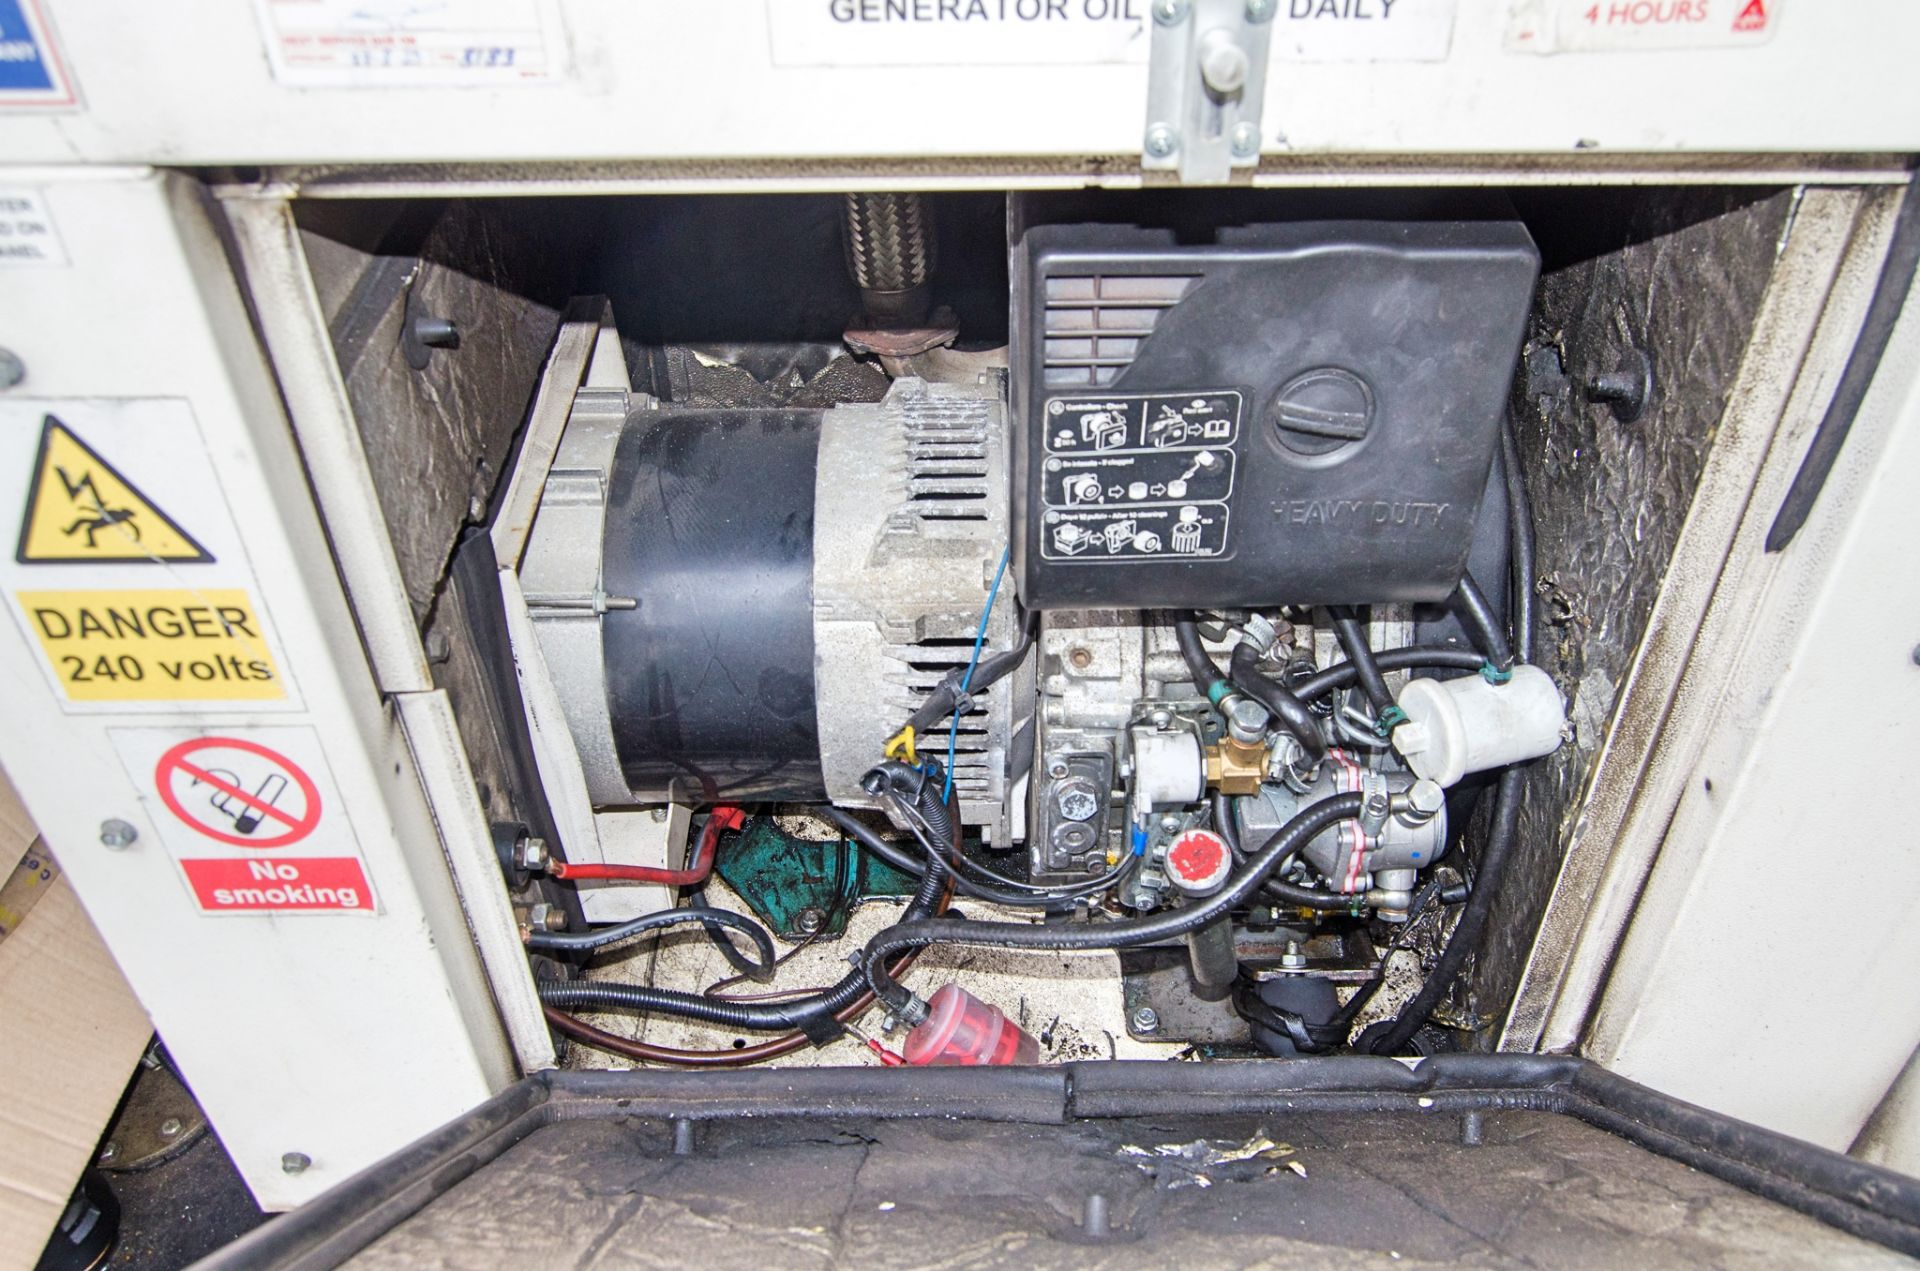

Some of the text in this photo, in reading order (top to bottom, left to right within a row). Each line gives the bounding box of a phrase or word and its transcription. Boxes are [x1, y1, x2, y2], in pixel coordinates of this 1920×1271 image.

[829, 0, 1397, 22] GENERATOR OIL DAILY
[1585, 0, 1707, 24] 4 HOURS
[1270, 500, 1450, 526] HEAVY DUTY
[35, 607, 257, 640] DANGER
[61, 653, 275, 682] 240 volts
[247, 861, 300, 882] No
[212, 885, 361, 908] smoking
